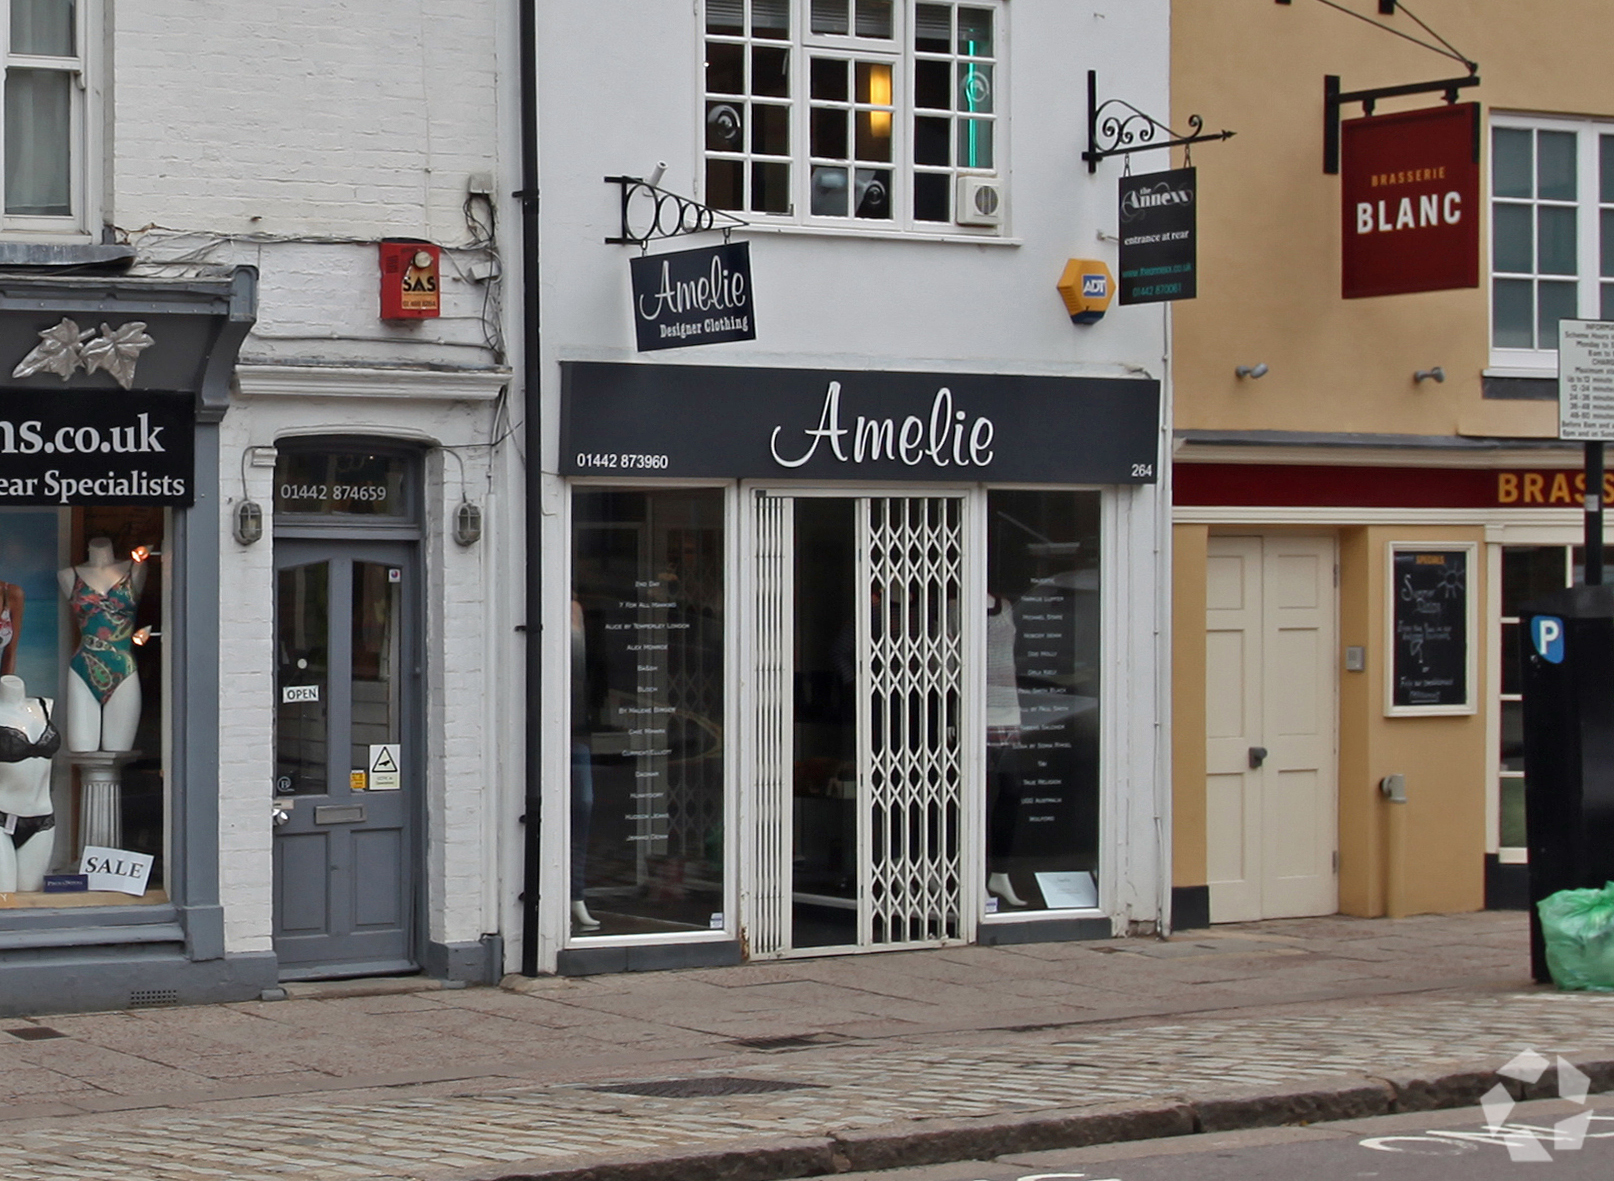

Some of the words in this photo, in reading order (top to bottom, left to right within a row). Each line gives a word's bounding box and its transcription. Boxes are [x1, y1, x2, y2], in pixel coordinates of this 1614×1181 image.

[1371, 166, 1446, 187] BRASSERIE
[1357, 191, 1461, 234] BLANC
[1124, 234, 1160, 246] entrance
[1162, 232, 1171, 242] at
[1172, 230, 1189, 240] rear
[403, 276, 436, 292] SAS
[640, 255, 746, 320] Amelie
[1083, 280, 1106, 293] ADT
[660, 323, 702, 339] Designer
[704, 316, 749, 333] Clothing
[771, 381, 994, 468] Amelie
[577, 453, 617, 468] 01442
[620, 454, 669, 469] 873960
[1131, 464, 1152, 477] 264
[44, 470, 185, 504] Specialists
[281, 484, 327, 500] 01442
[333, 485, 386, 501] 874659
[1540, 620, 1559, 655] P
[287, 689, 317, 700] OPEN
[85, 857, 144, 879] SALE
